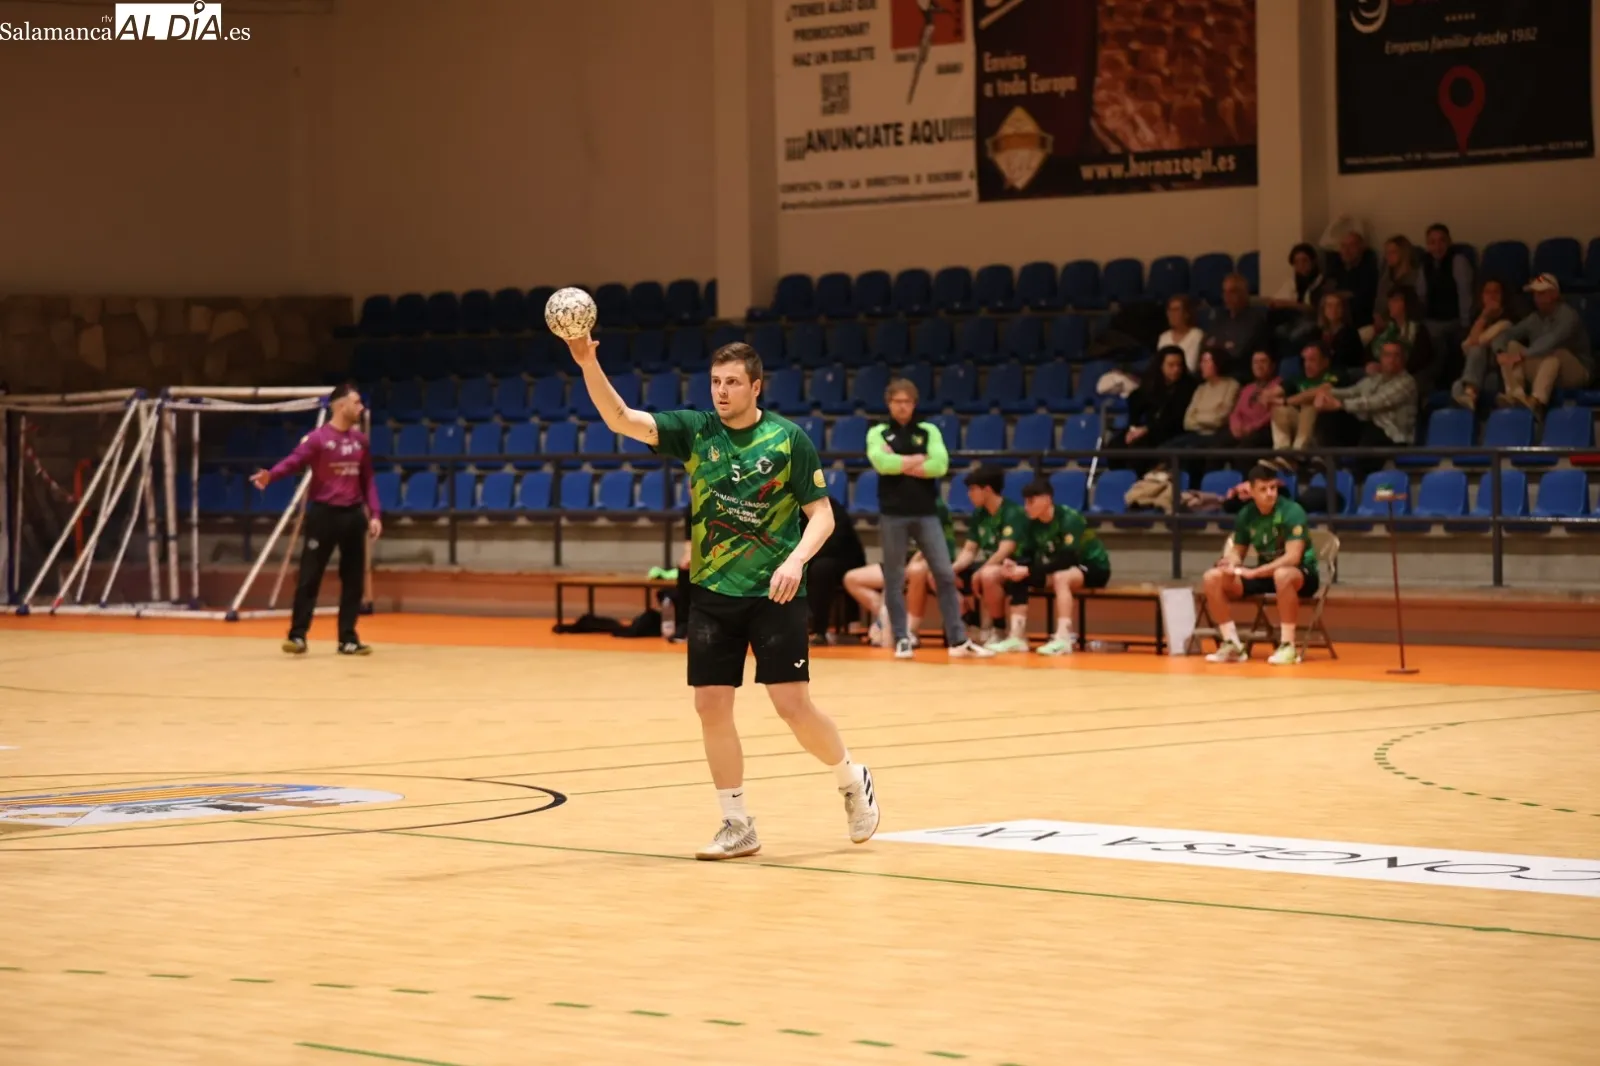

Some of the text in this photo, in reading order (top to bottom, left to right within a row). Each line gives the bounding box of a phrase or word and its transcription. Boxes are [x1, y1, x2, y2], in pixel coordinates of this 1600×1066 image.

[1384, 39, 1430, 57] Empresa
[1429, 34, 1473, 54] familiar
[1472, 30, 1509, 48] desde
[1029, 71, 1078, 98] Europa
[731, 463, 741, 482] 5
